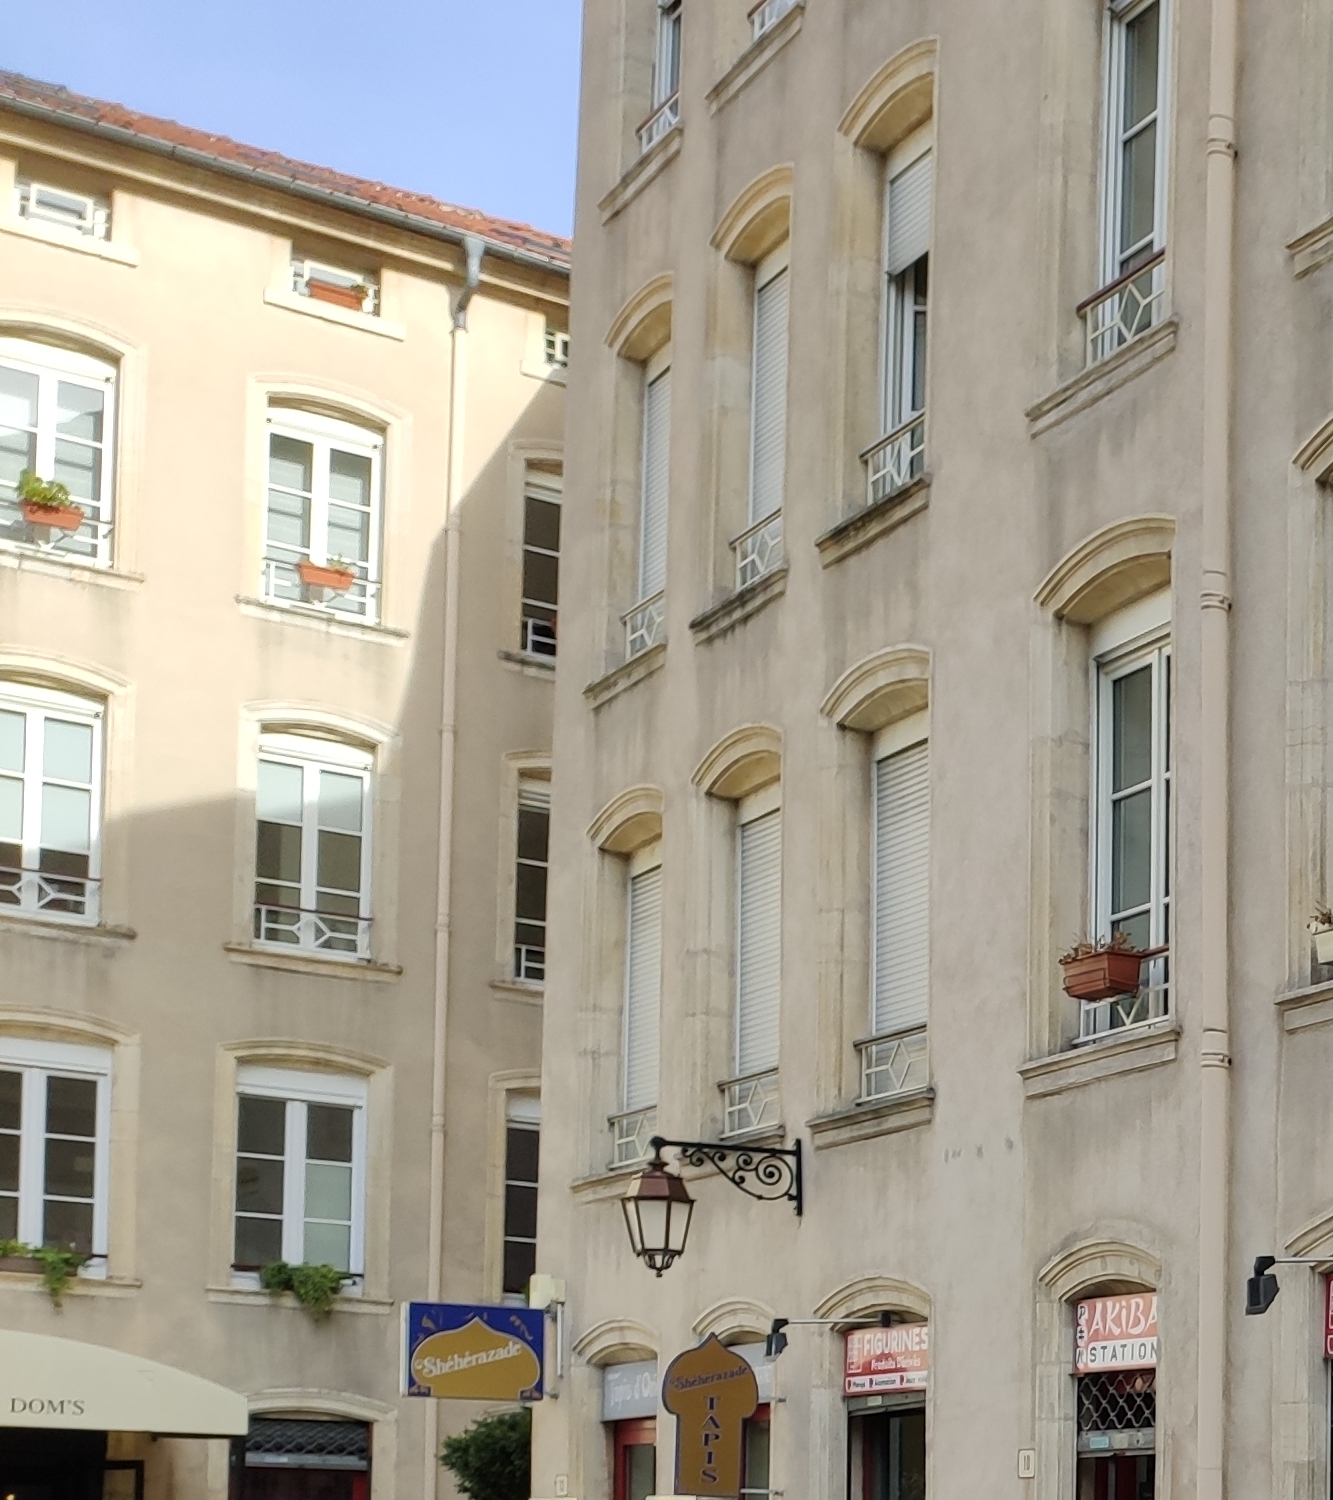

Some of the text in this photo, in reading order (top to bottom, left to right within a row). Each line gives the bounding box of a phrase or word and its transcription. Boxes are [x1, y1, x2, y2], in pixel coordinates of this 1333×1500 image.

[863, 1326, 928, 1357] FIGURINES
[9, 1396, 86, 1416] DOM'S
[701, 1395, 721, 1484] TAPIS
